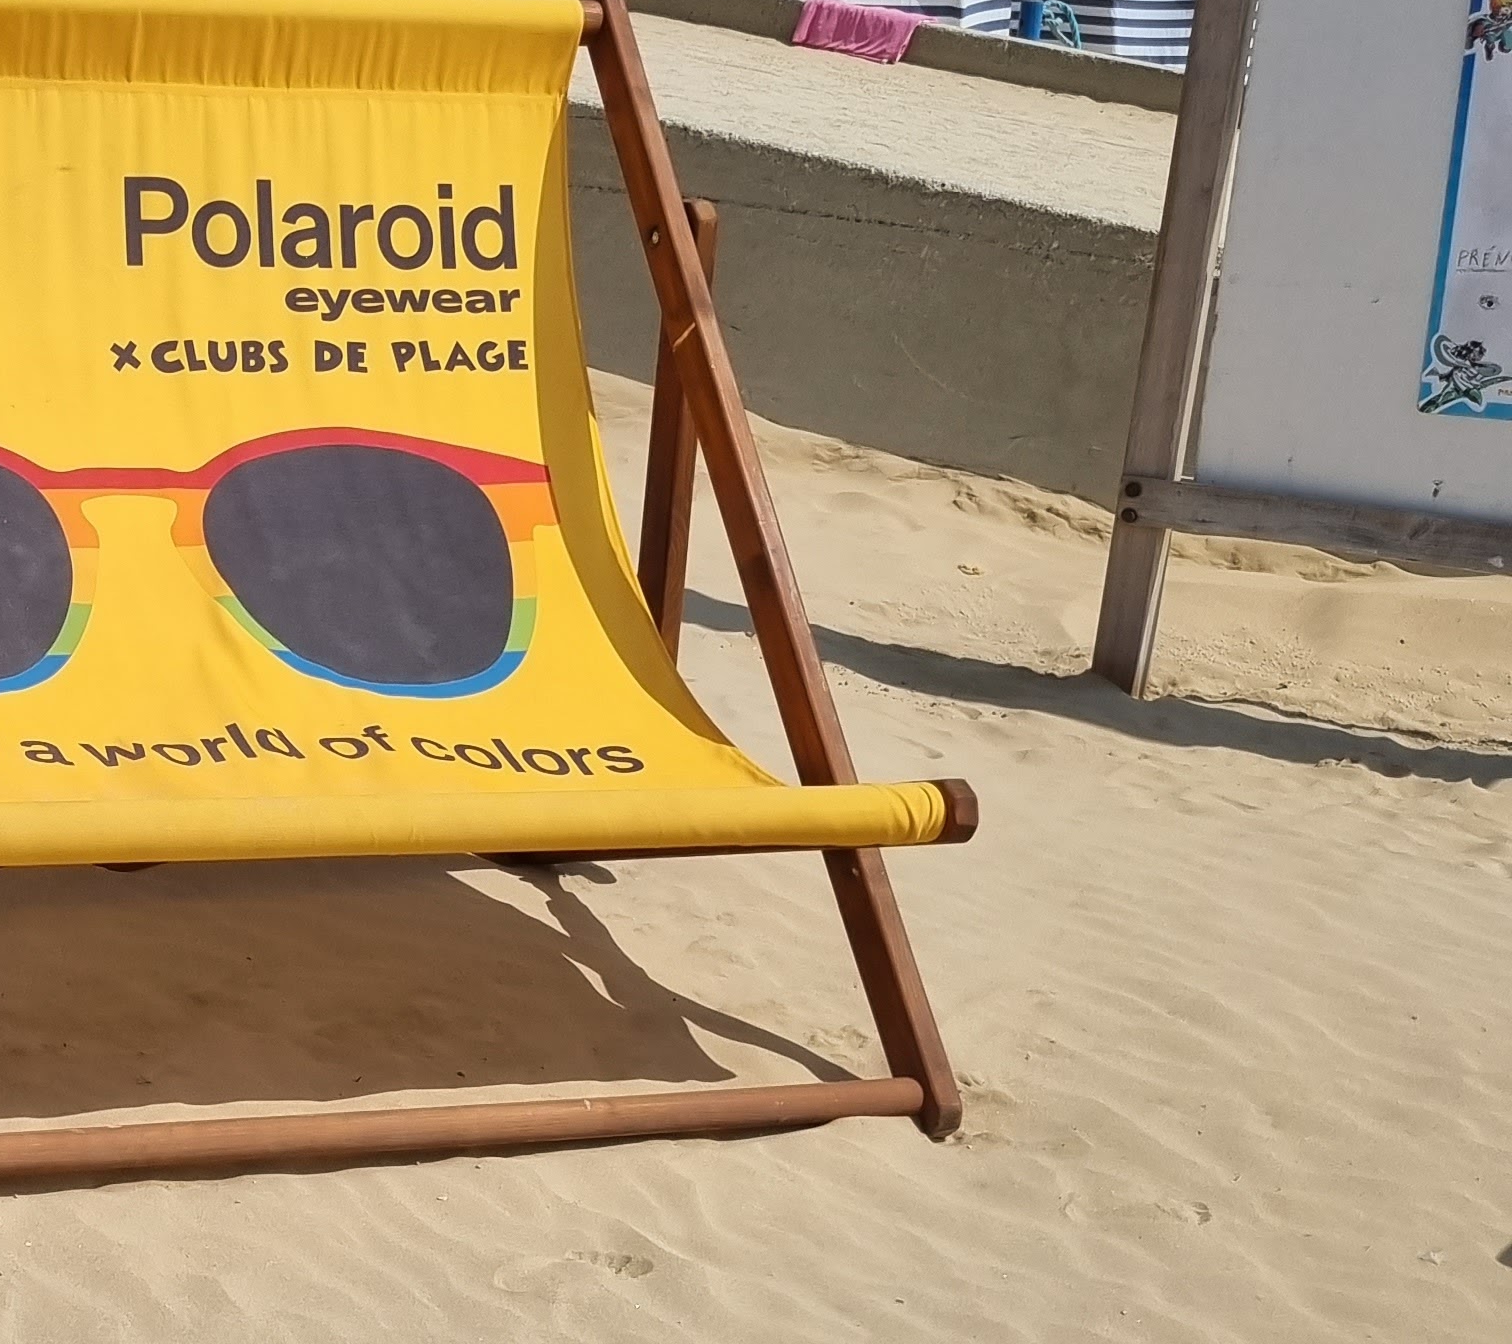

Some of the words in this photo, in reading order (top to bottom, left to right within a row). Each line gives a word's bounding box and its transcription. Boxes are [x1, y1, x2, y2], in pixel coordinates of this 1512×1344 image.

[123, 176, 518, 271] Polaroid
[1457, 245, 1512, 268] PRÉN
[284, 286, 521, 322] eyewear
[150, 340, 289, 373] CLUBS
[314, 340, 368, 373] DE
[391, 340, 529, 373] PLAGE
[19, 739, 75, 766] a
[79, 722, 306, 767] world
[318, 724, 397, 759] of
[410, 736, 645, 776] colors
